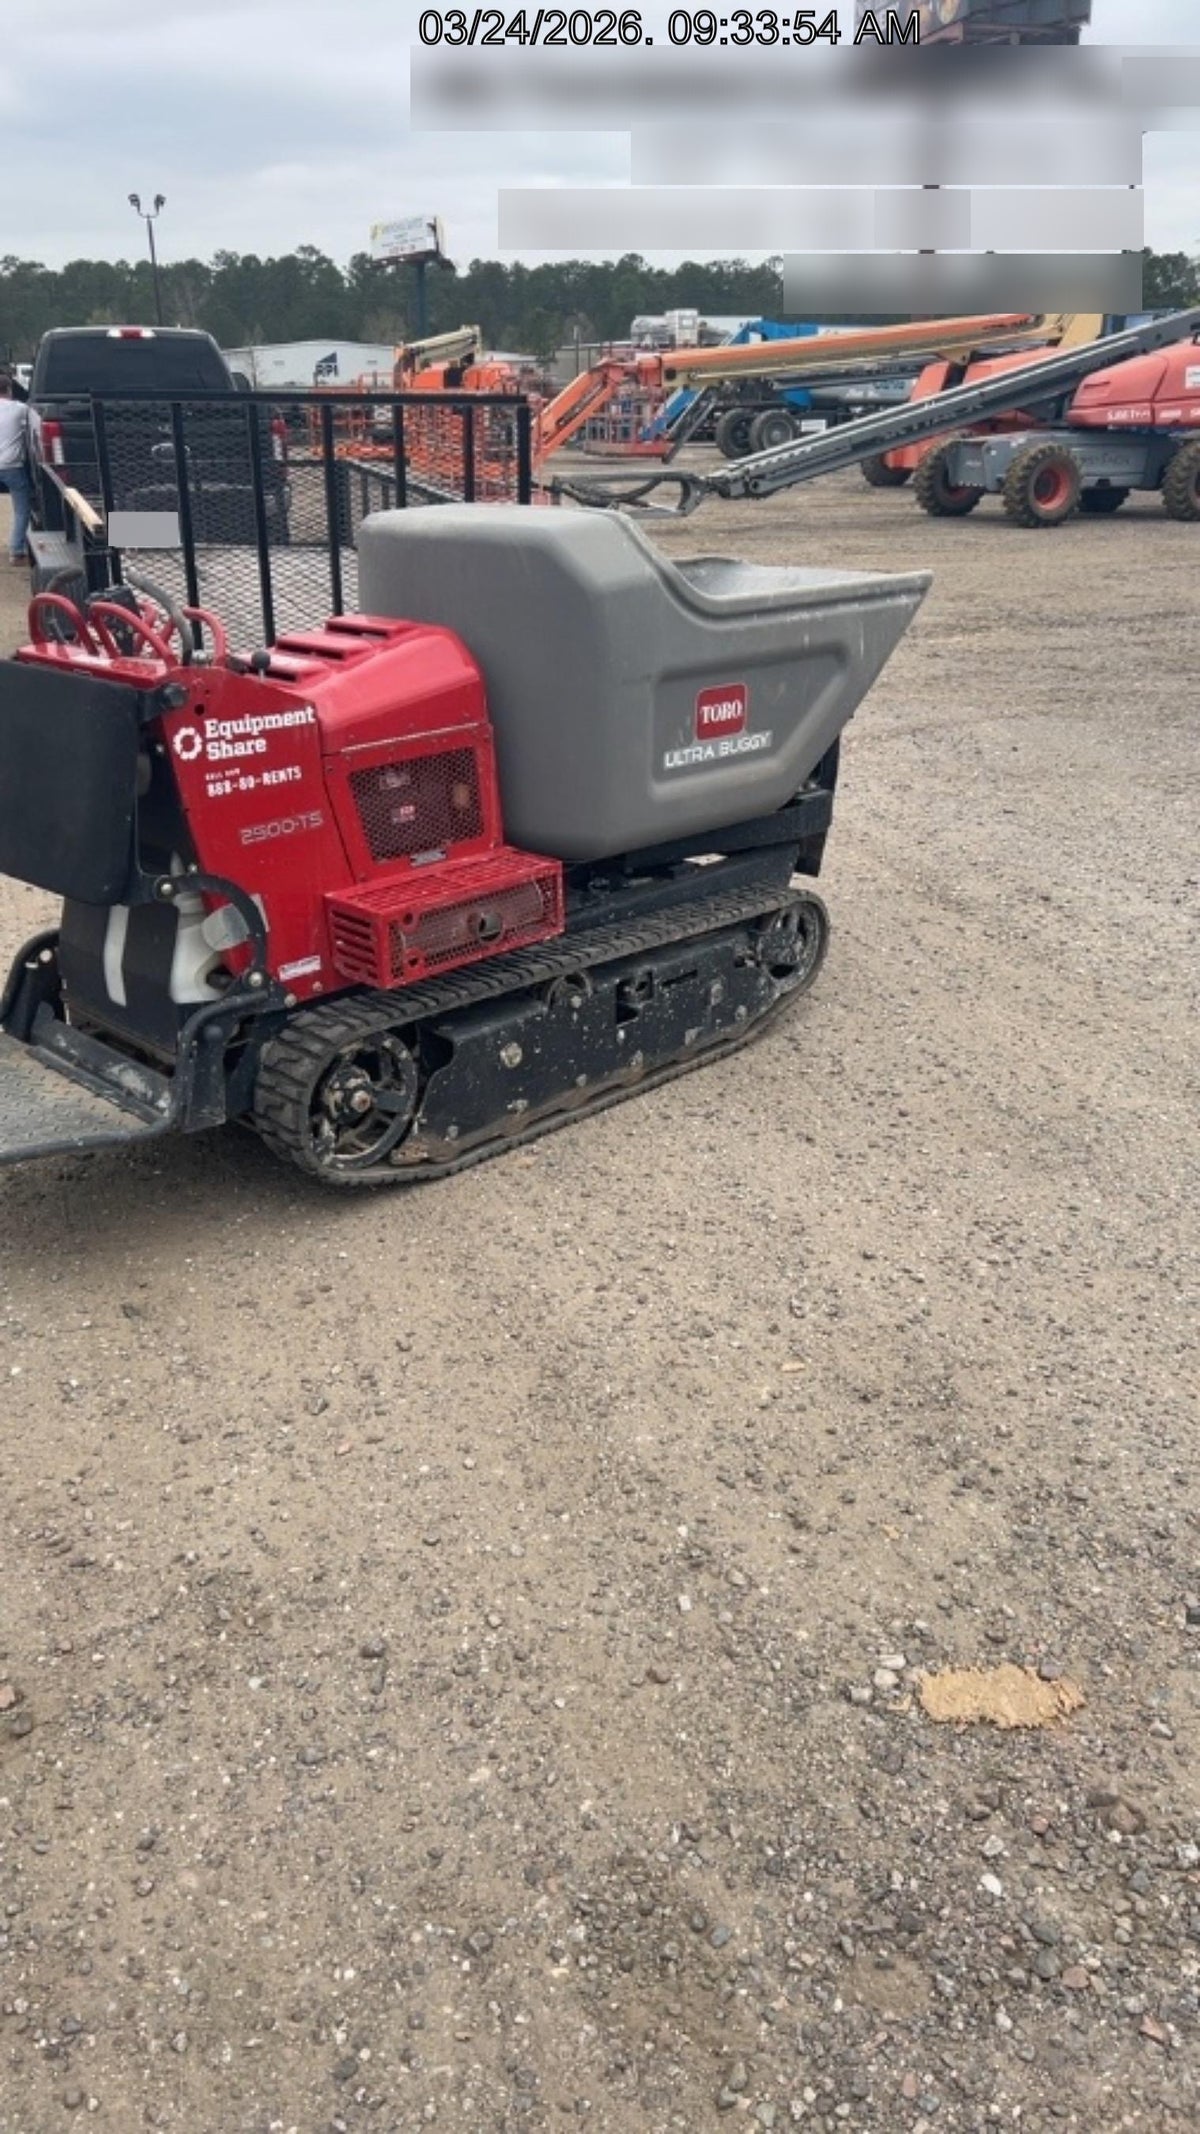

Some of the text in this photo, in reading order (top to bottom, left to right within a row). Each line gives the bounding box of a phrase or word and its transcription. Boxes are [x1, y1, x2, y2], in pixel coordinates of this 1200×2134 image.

[204, 706, 315, 739] Equipment
[700, 699, 743, 724] TORO
[206, 738, 267, 760] Share
[665, 732, 772, 768] ULTRA BUGGY
[207, 766, 302, 797] 888-80-RENTS
